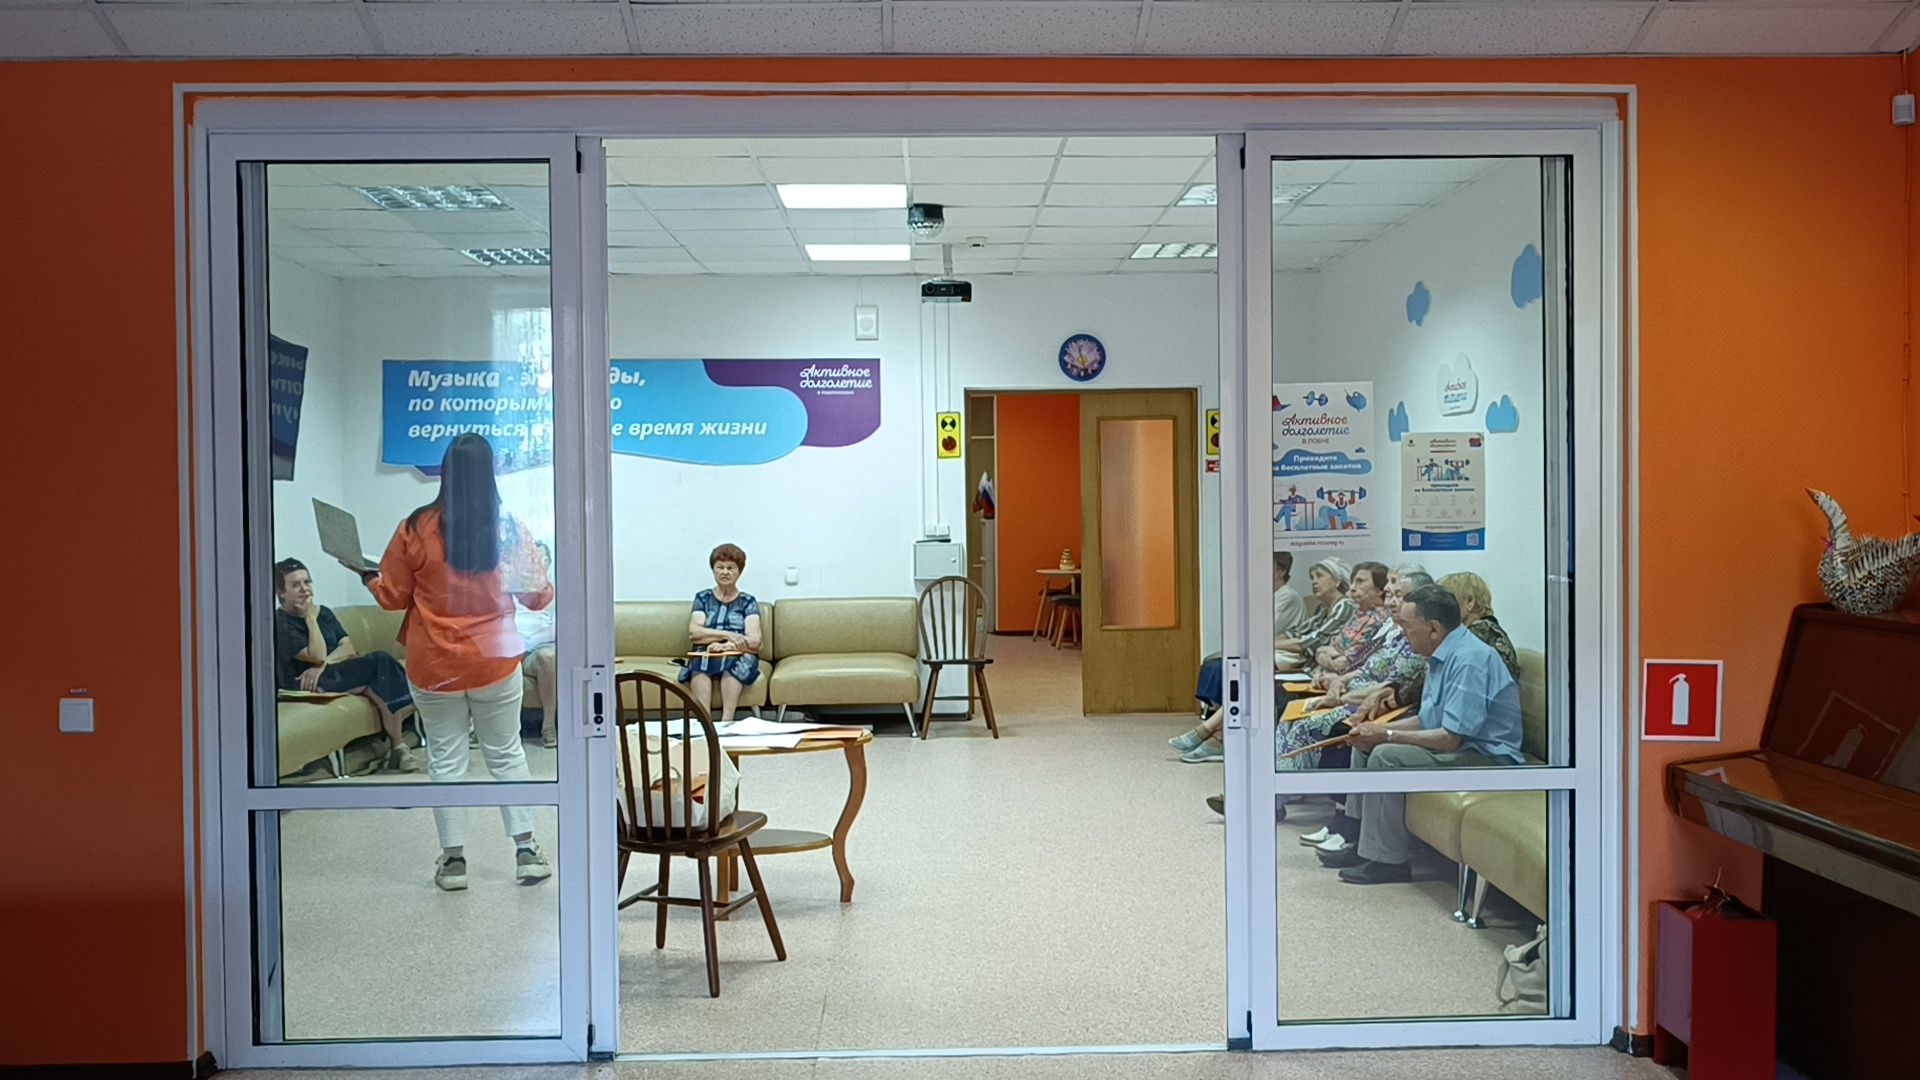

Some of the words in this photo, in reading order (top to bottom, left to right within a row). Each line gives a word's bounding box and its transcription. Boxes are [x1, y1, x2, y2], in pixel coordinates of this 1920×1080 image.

[799, 363, 871, 378] Активное
[408, 369, 500, 392] Музыка
[799, 377, 873, 389] долголетие
[408, 397, 435, 412] по
[440, 396, 543, 416] которым
[1281, 412, 1348, 427] Активное
[408, 422, 527, 442] вернуться
[628, 421, 694, 441] время
[699, 421, 767, 436] жизни
[1282, 425, 1350, 437] долголетие
